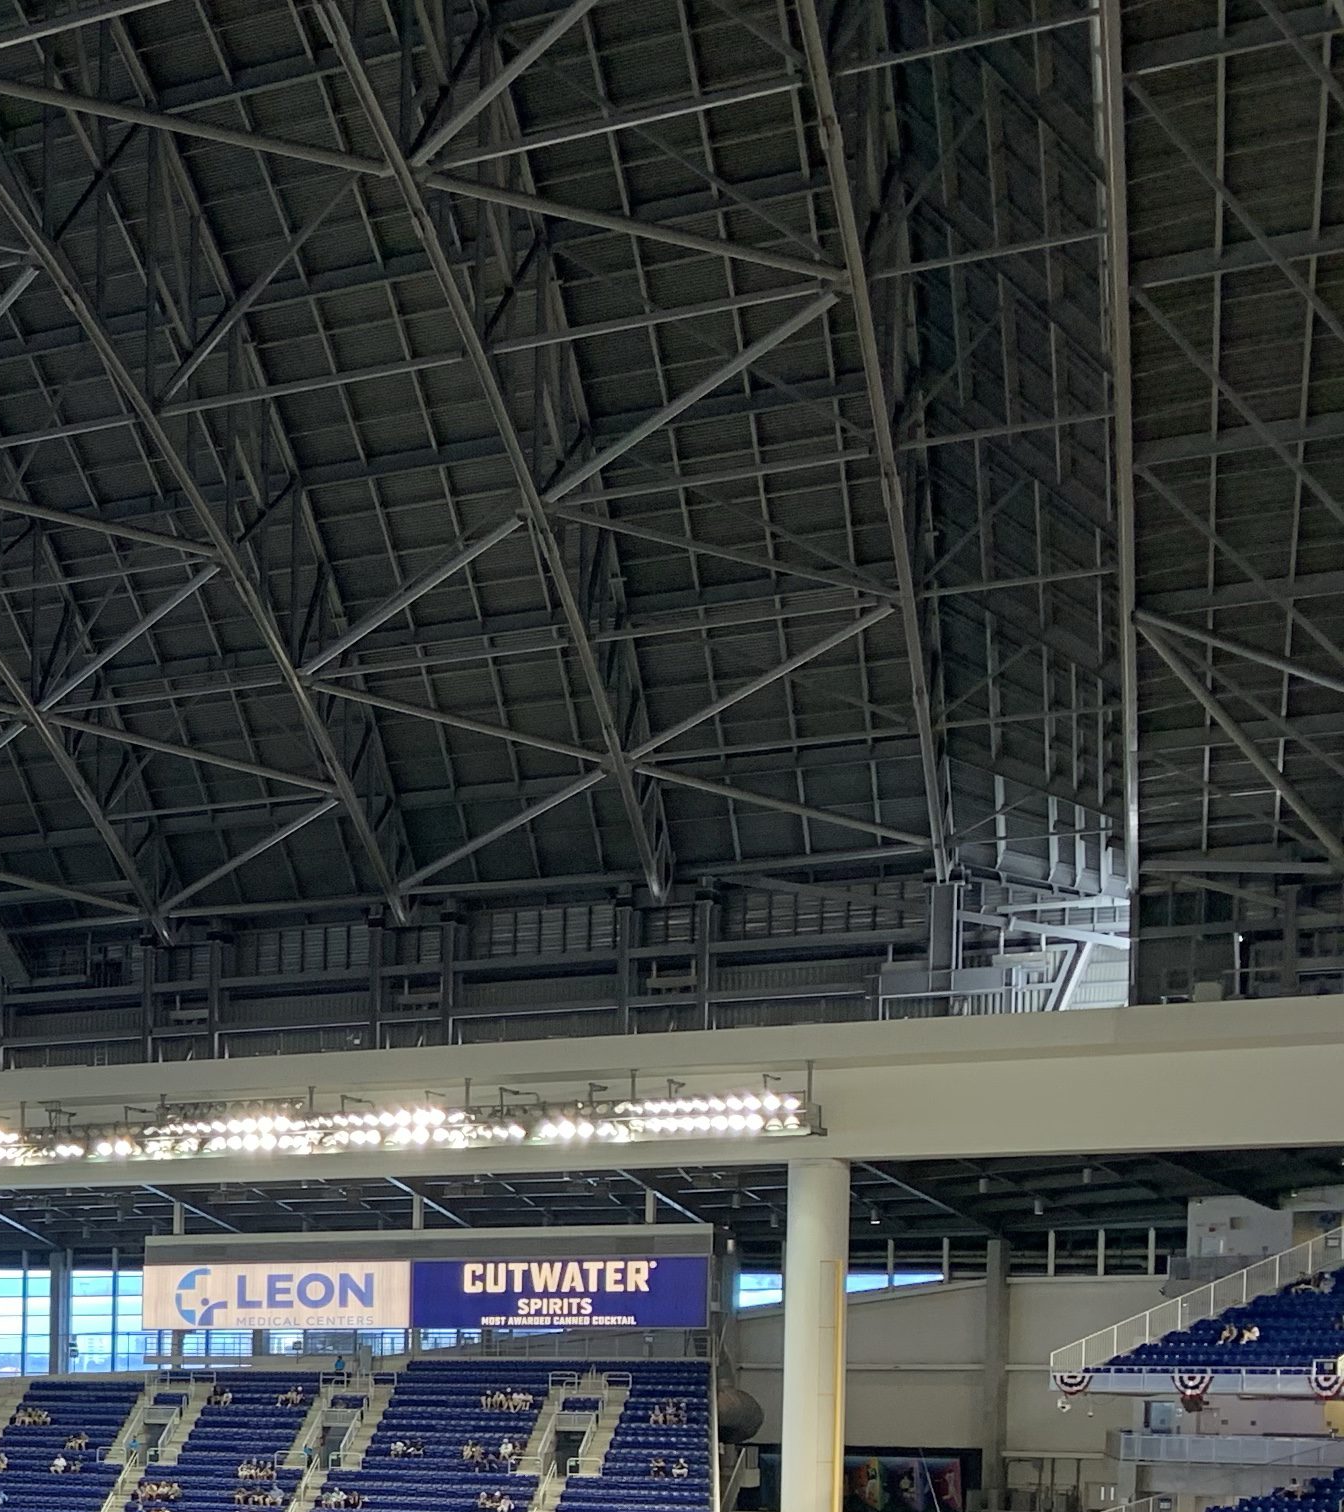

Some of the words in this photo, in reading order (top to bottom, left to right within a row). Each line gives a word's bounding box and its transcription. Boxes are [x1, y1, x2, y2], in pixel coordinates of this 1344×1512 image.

[463, 1261, 650, 1293] CUTWATER
[237, 1273, 374, 1309] LEON
[517, 1298, 592, 1314] SPIRITS
[237, 1317, 298, 1327] MEDICAL
[305, 1316, 374, 1326] CENTERS
[481, 1316, 506, 1326] MOST
[508, 1316, 551, 1326] AWARDED
[553, 1316, 590, 1325] CANNED
[592, 1316, 637, 1325] COCKTAIL
